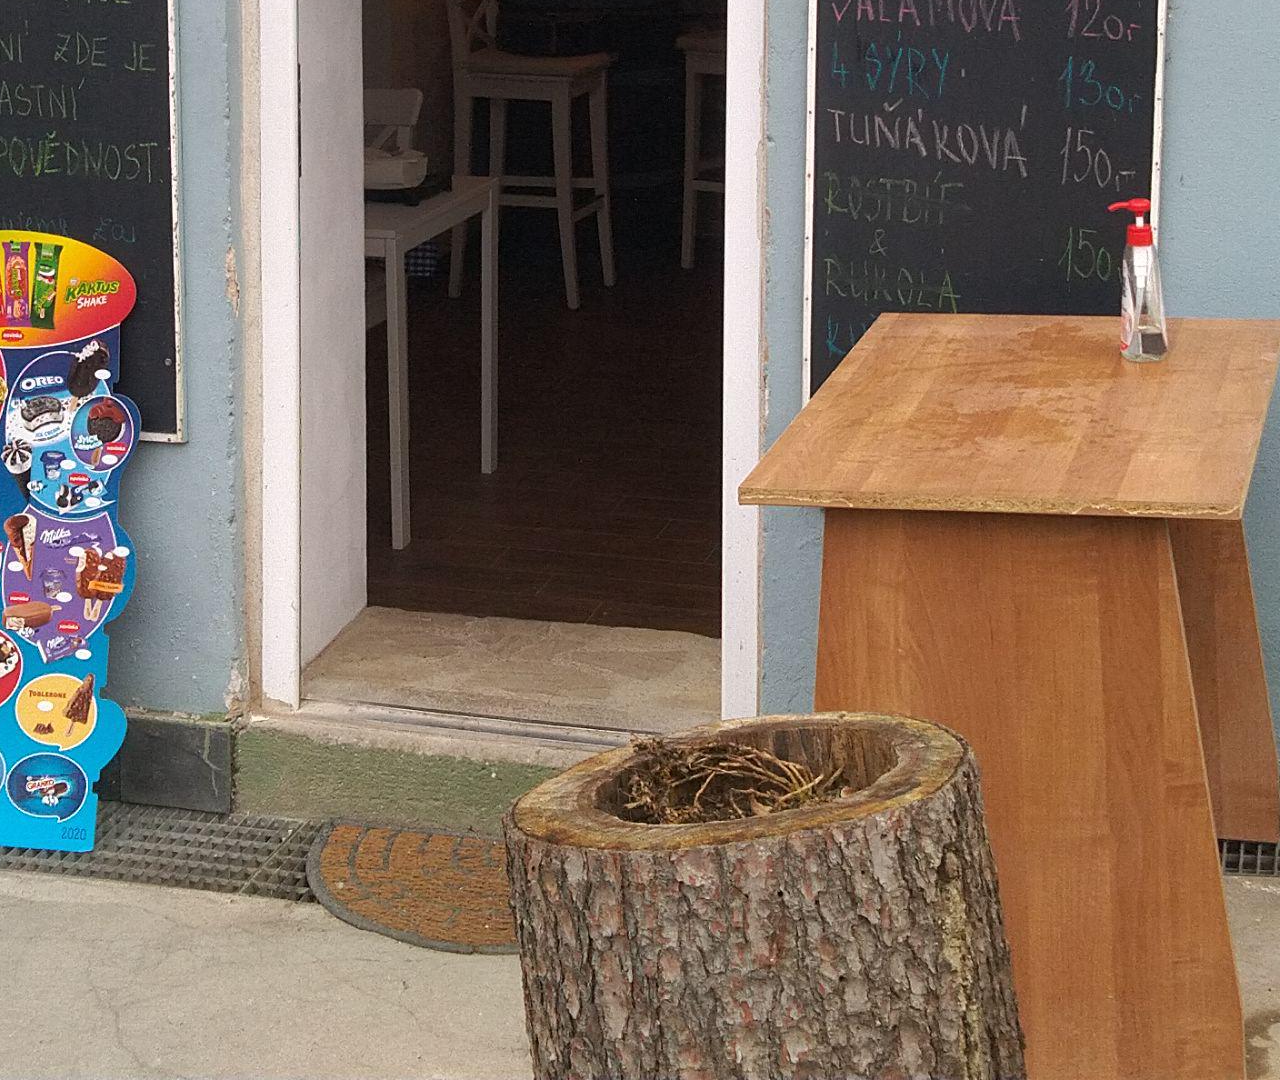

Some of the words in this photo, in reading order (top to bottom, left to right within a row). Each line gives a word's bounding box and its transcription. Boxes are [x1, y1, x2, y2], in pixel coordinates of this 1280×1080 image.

[54, 31, 108, 67] ZDE
[124, 40, 157, 71] JE
[832, 41, 849, 89] 4
[64, 280, 120, 303] KAKTUS
[77, 295, 108, 309] SHAKE
[21, 375, 64, 392] OREO
[40, 528, 71, 543] Milka
[29, 689, 66, 699] TOBLERONE
[61, 827, 86, 840] 2020
